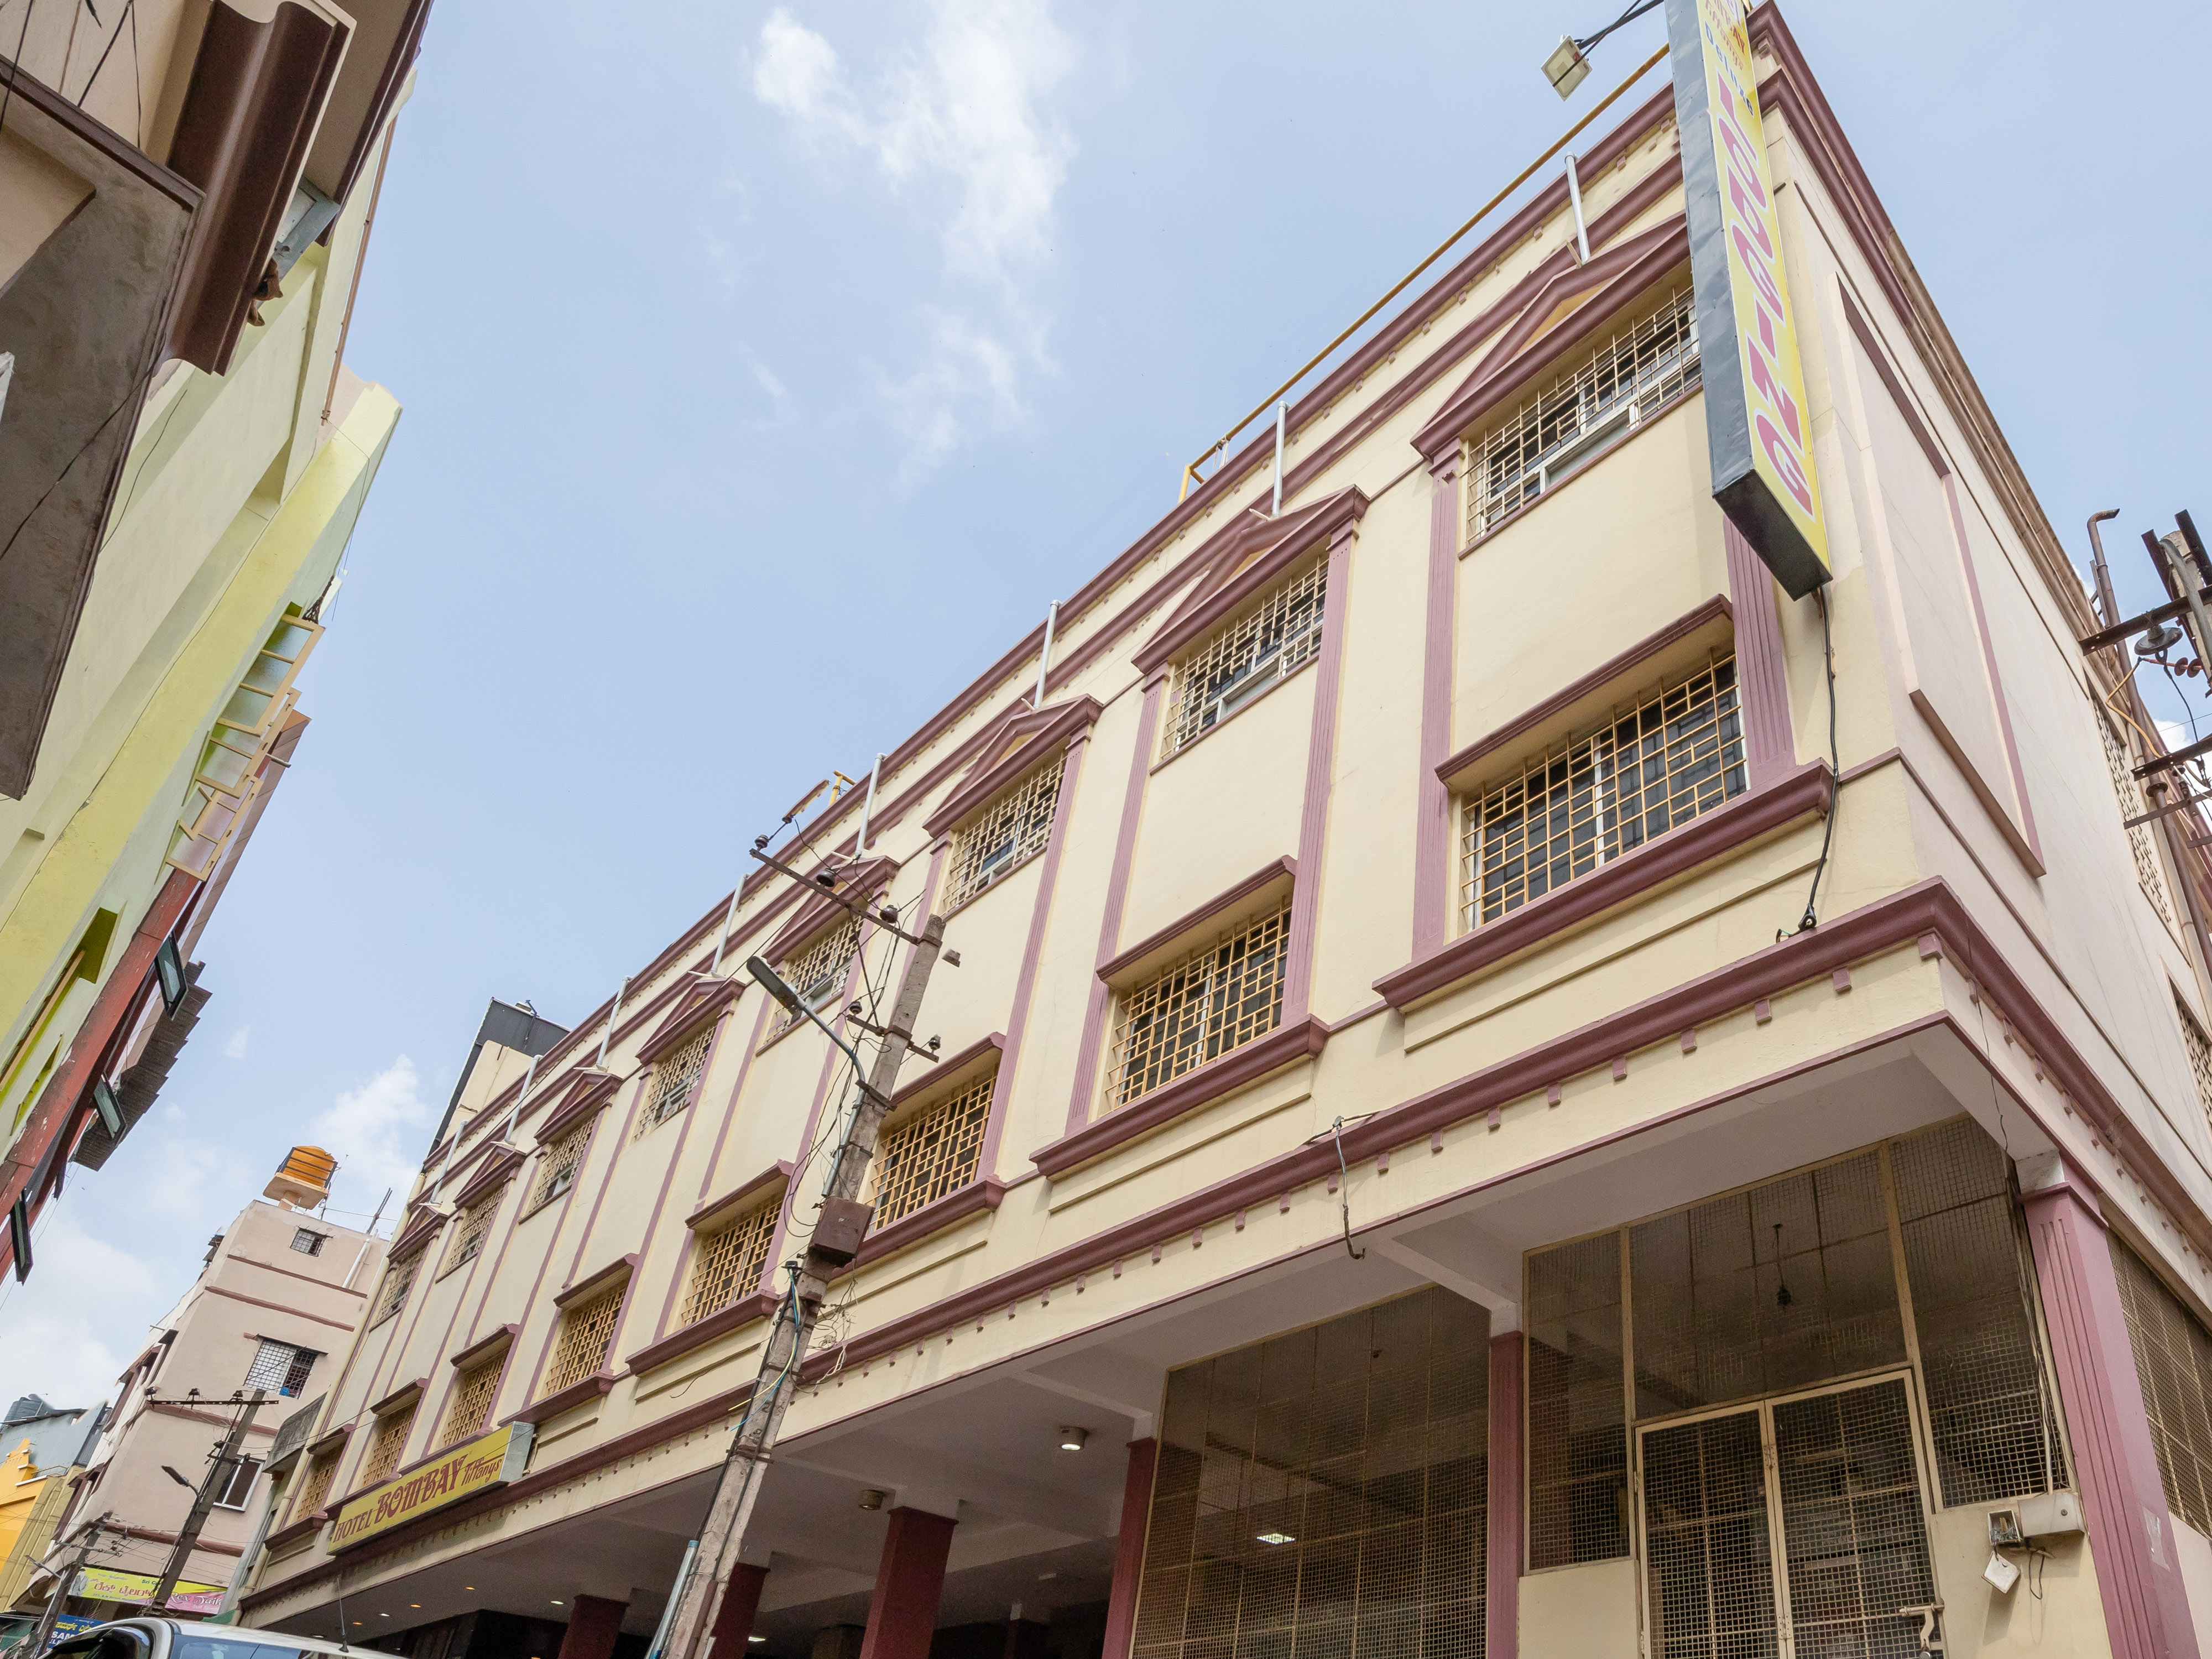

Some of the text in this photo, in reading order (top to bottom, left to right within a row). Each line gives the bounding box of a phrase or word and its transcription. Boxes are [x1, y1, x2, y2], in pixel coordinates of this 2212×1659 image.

[1704, 20, 1754, 116] Deluxe
[1717, 70, 1814, 519] LODGING
[333, 1454, 503, 1543] HOTEL BOMBAY Tiffanys
